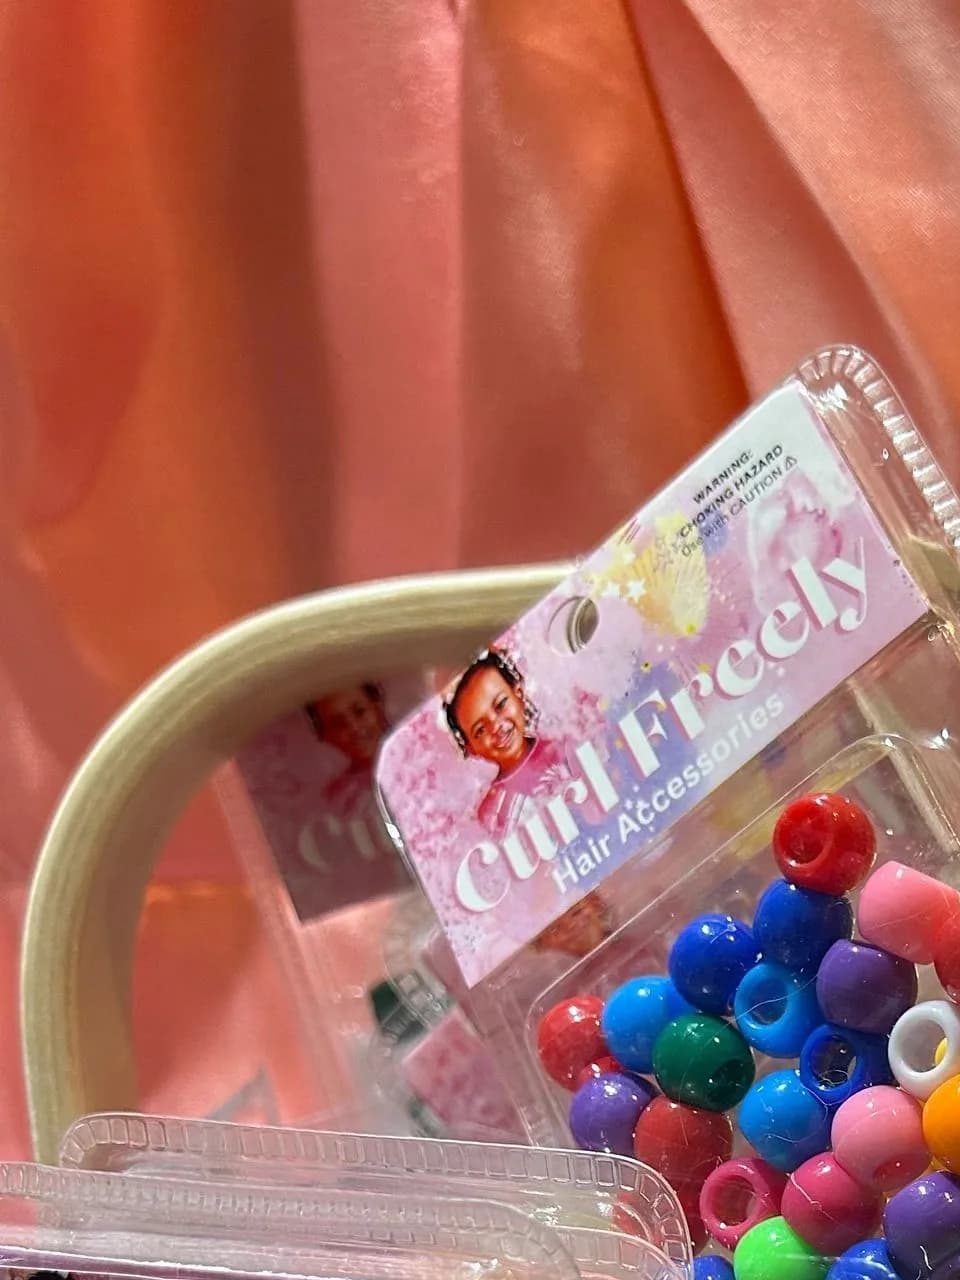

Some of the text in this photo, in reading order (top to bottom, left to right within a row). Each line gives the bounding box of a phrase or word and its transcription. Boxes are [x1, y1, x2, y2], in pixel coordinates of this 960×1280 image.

[680, 444, 783, 538] CHOKING HAZARD
[693, 449, 754, 504] WARNING:
[729, 467, 783, 517] CAUTION
[453, 536, 870, 914] Curl Freely
[551, 692, 786, 894] Hair Accessories
